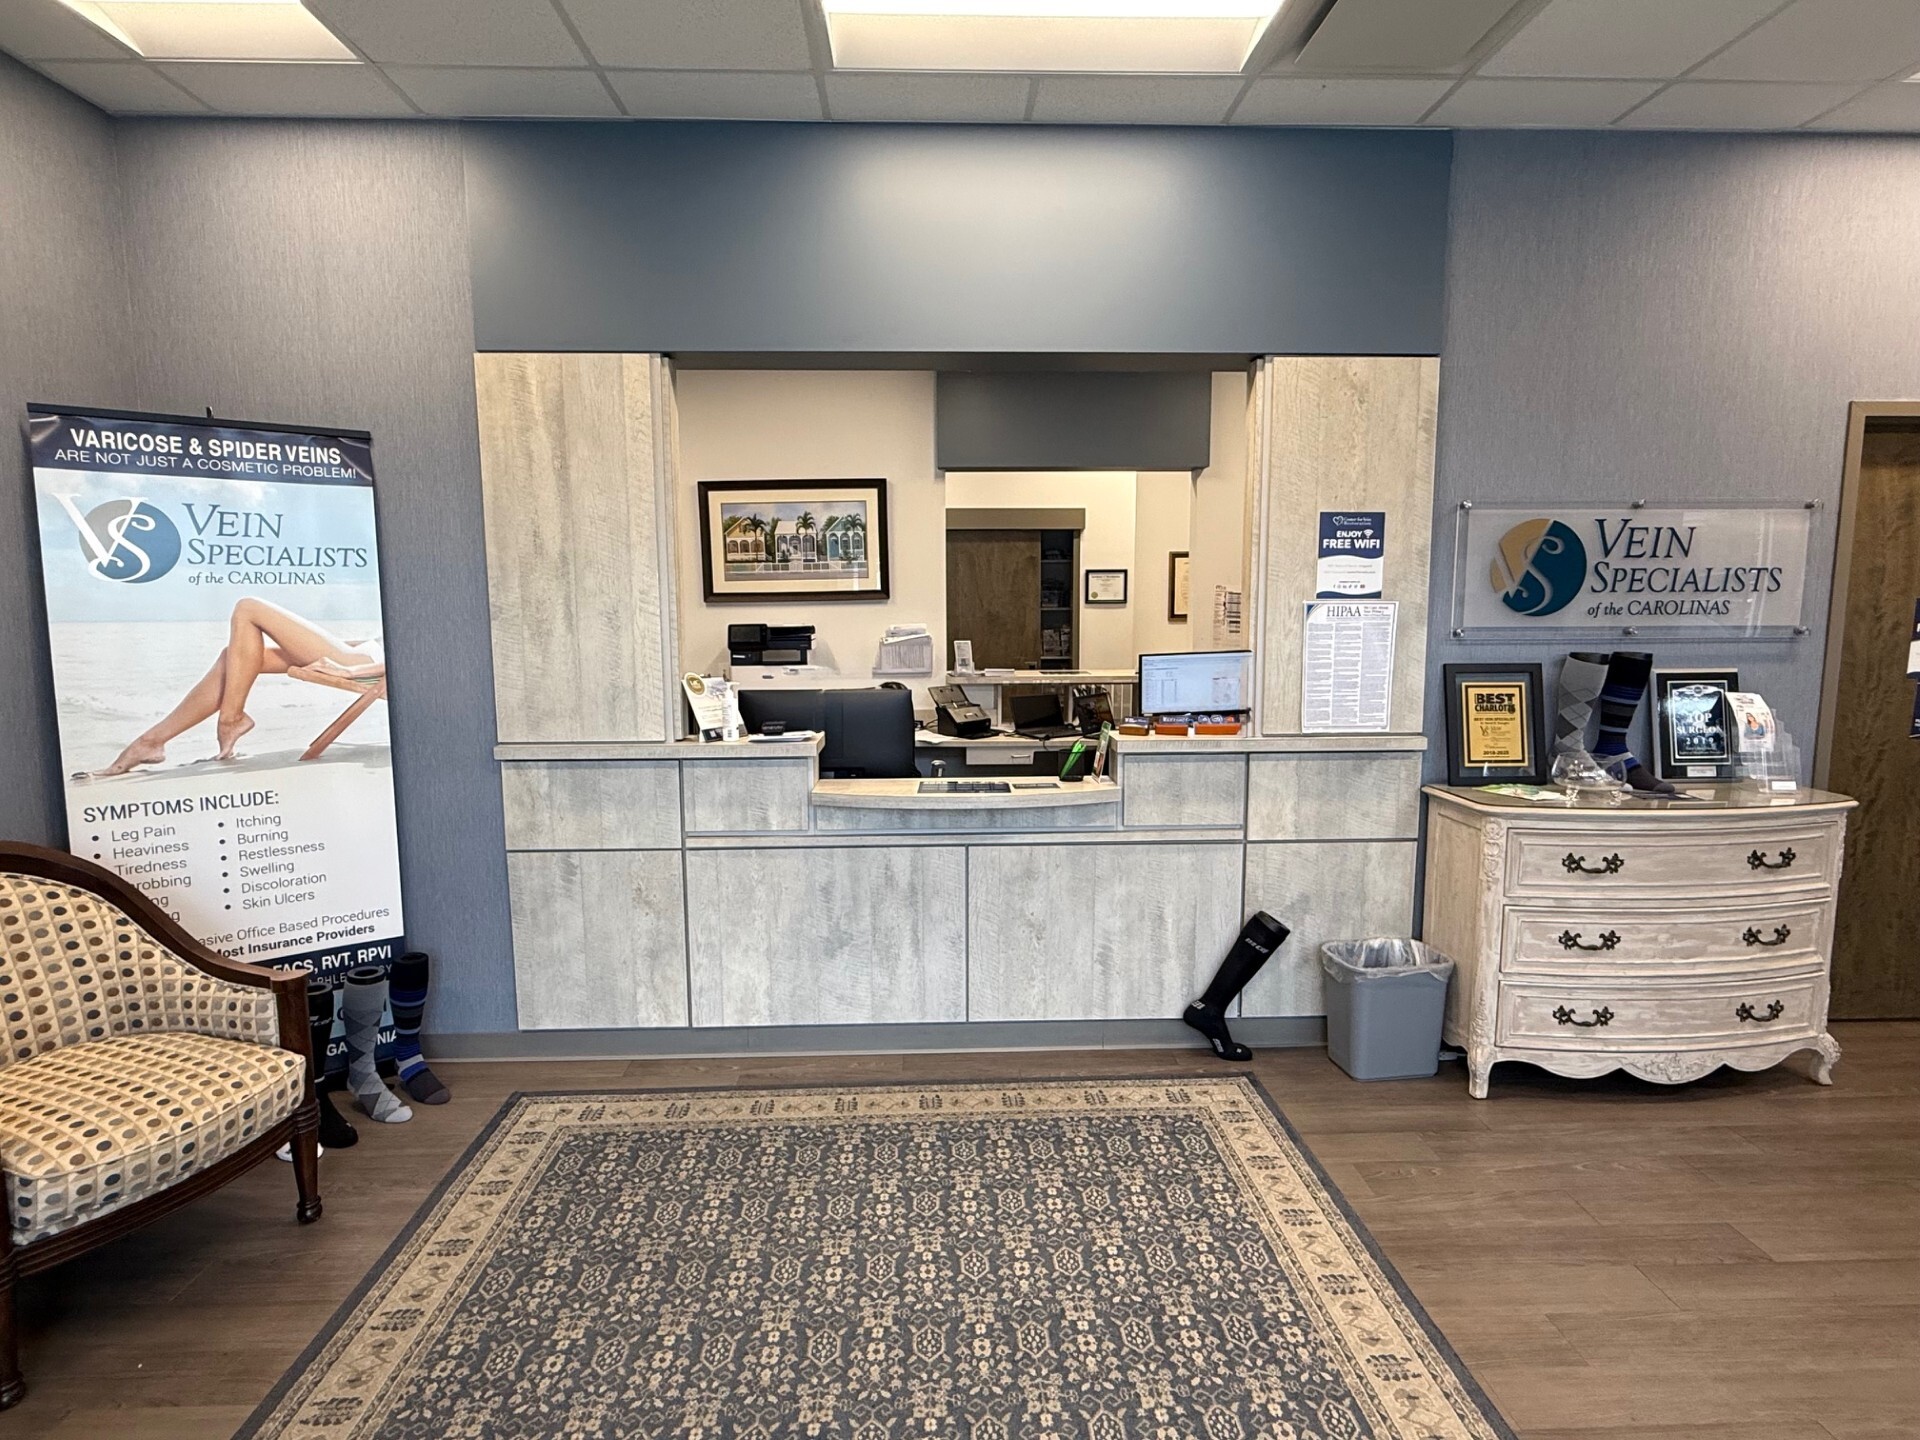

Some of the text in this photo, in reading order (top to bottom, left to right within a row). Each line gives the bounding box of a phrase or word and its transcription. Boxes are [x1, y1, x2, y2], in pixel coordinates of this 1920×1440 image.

[70, 428, 342, 465] VARICOSE & SPIDER VEINS
[55, 448, 357, 479] ARE NOT JUST A COSMETIC PROBLEM!
[182, 503, 284, 540] VEIN
[1336, 530, 1363, 538] ENJOY
[1594, 518, 1696, 558] VEIN
[1322, 538, 1352, 549] FREE
[187, 539, 368, 568] SPECIALISTS
[188, 571, 326, 586] of the CAROLINAS
[1591, 562, 1783, 593] SPECIALISTS
[1327, 605, 1361, 617] HIPAA
[1587, 600, 1730, 618] of the CAROLINAS
[1475, 693, 1515, 704] BEST
[1688, 712, 1712, 722] TOP
[1676, 725, 1724, 734] SURGEON
[1686, 737, 1714, 745] 2019
[84, 790, 280, 823] SYMPTOMS INCLUDE:
[236, 814, 282, 829] Itching
[111, 825, 176, 843] Leg Pain
[237, 829, 289, 845] Burning
[113, 841, 190, 859] Heaviness
[239, 841, 326, 862] Restlessness
[114, 859, 187, 877] Tiredness
[239, 861, 295, 878] Swelling
[131, 875, 192, 891] robbing
[241, 872, 327, 894] Discoloration
[242, 889, 315, 910] Skin Ulcers
[236, 925, 276, 942] Office
[279, 918, 319, 934] Based
[321, 907, 390, 931] Procedures
[216, 923, 375, 959] ost Insurance Providers
[322, 952, 354, 970] RVT,
[357, 945, 392, 964] RPVI
